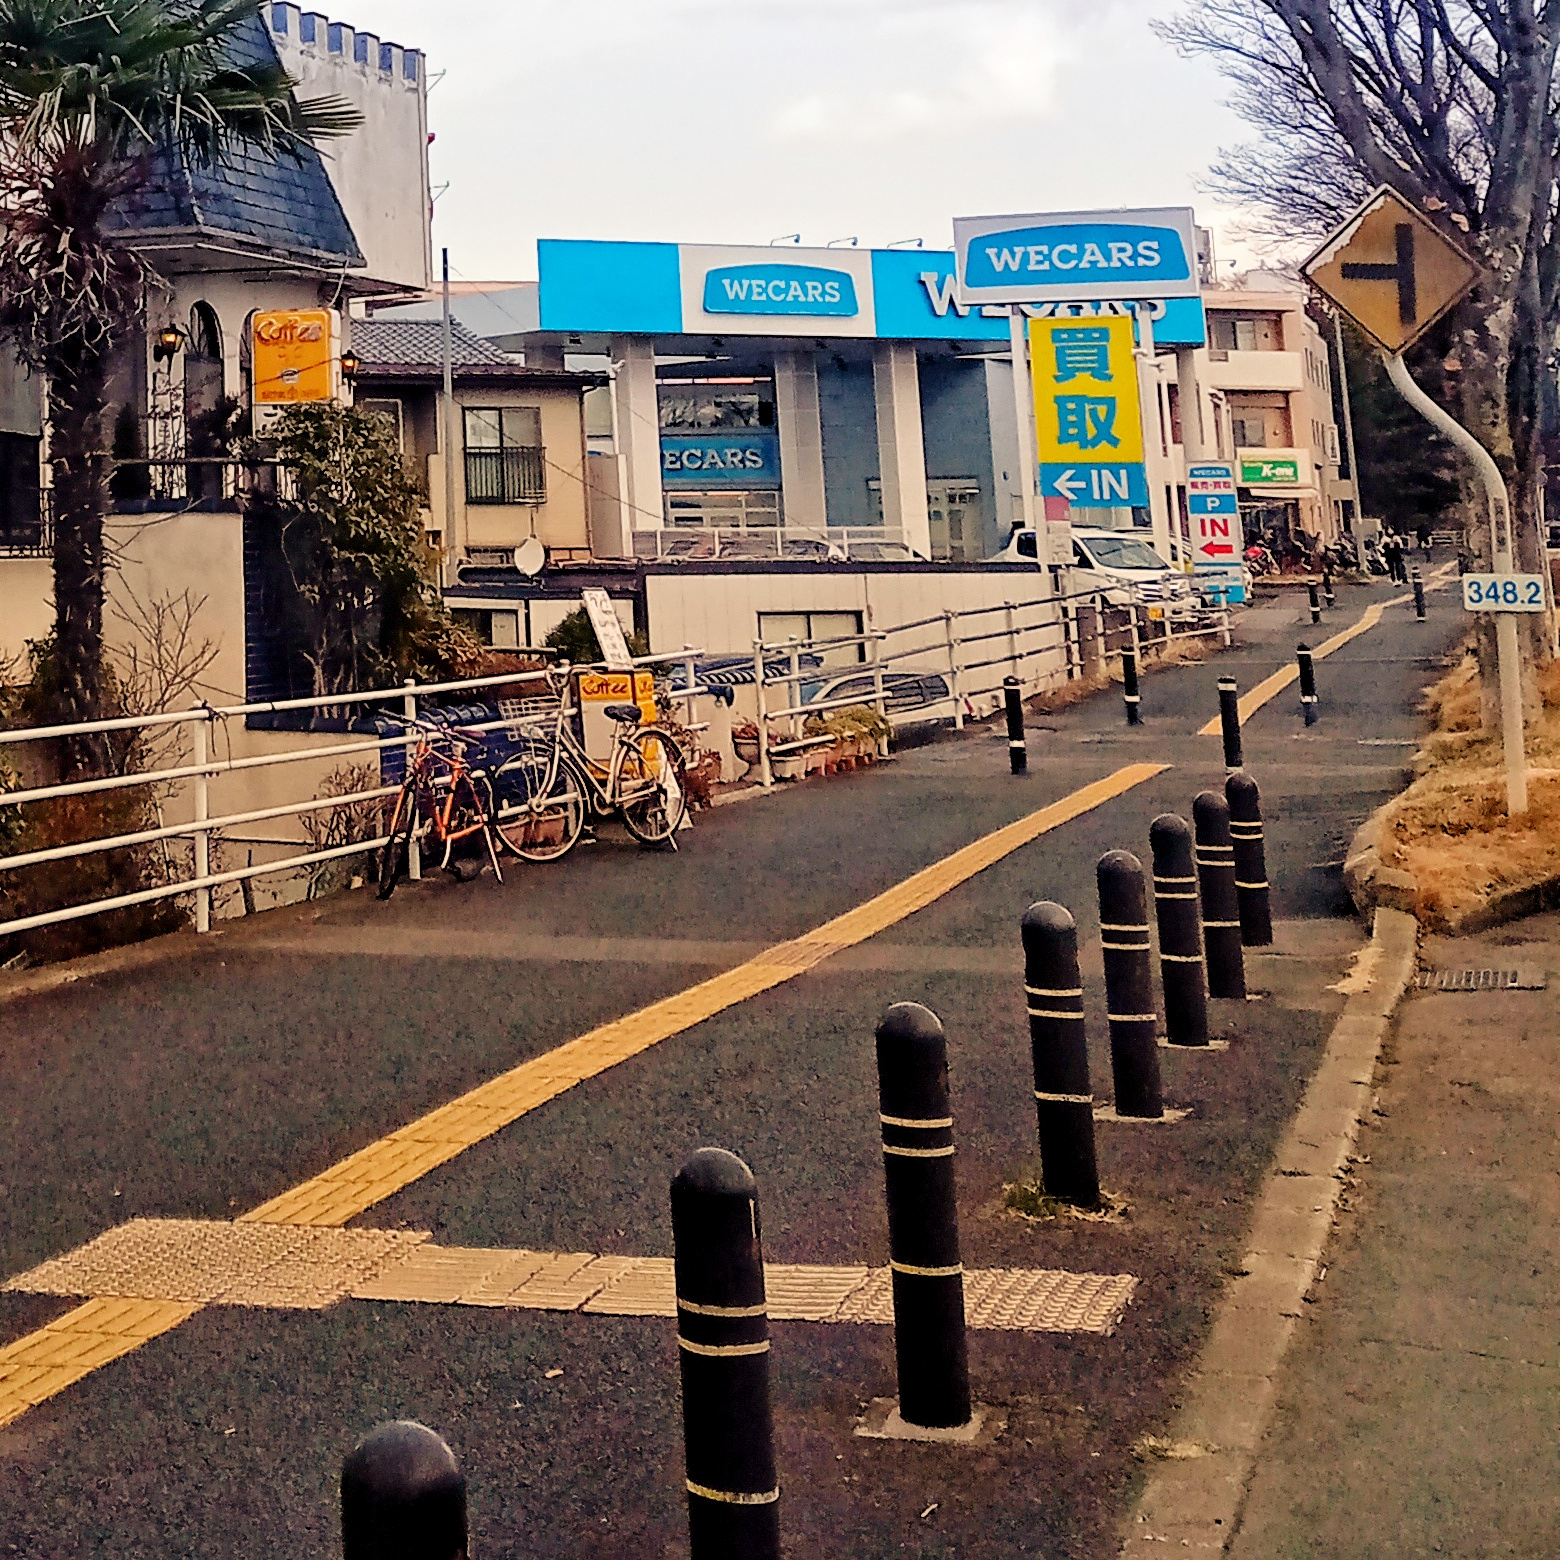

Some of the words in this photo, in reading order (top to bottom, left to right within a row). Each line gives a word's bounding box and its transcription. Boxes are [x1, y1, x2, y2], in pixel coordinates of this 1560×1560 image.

[985, 241, 1161, 272] WECARS
[722, 278, 841, 303] WECARS
[1050, 327, 1121, 450] 買取
[1090, 469, 1130, 500] IN
[1207, 497, 1221, 511] P
[1200, 518, 1229, 537] IN
[1468, 581, 1542, 604] 348.2
[582, 679, 629, 696] Coffee
